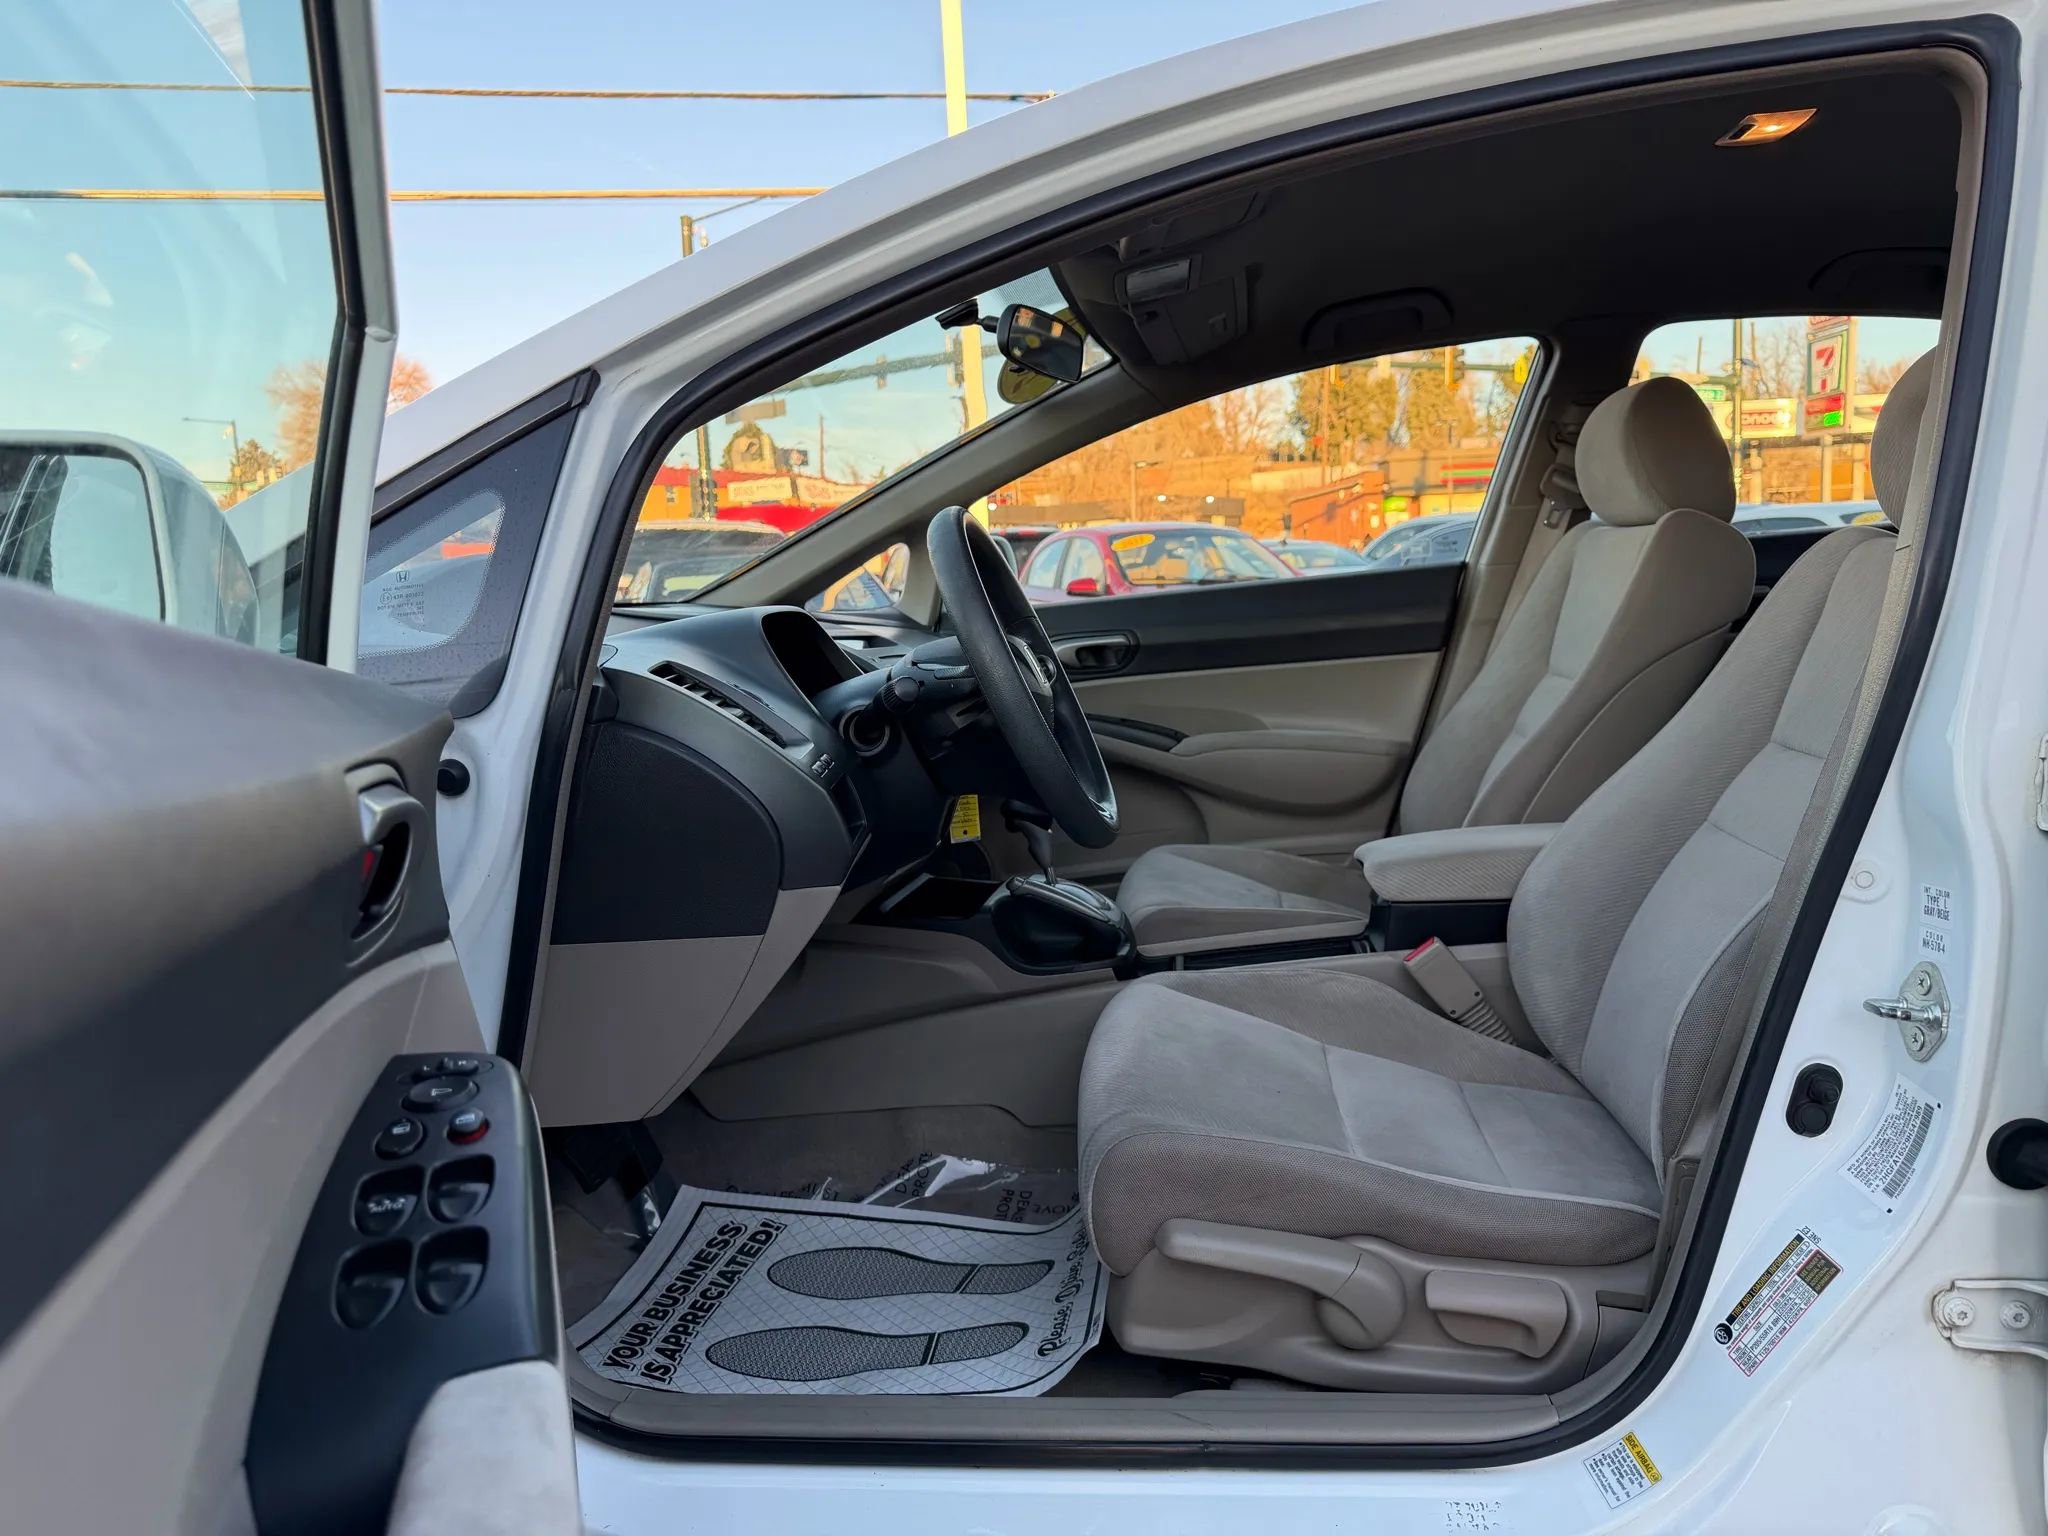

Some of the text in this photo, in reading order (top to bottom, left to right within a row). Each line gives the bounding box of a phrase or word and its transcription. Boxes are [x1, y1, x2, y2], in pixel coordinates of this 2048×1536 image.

[1926, 894, 1940, 907] TYPE
[1924, 904, 1950, 921] GRAY/BEIGE
[1925, 930, 1944, 942] COLOR
[1880, 1106, 1922, 1183] 2HGFA16529H547989
[1732, 1239, 1799, 1317] TIRE AND LOADING INFORMATION
[603, 1221, 747, 1371] YOUR BUSINESS
[654, 1218, 787, 1366] APPRECIATED!
[1037, 1302, 1072, 1356] Please
[1753, 1321, 1762, 1331] SIZE
[1737, 1349, 1748, 1362] FRONT
[1742, 1355, 1752, 1366] REAR
[640, 1359, 676, 1384] IS
[1747, 1360, 1758, 1373] SPARE
[1626, 1435, 1653, 1473] SIDE AIRBAG
